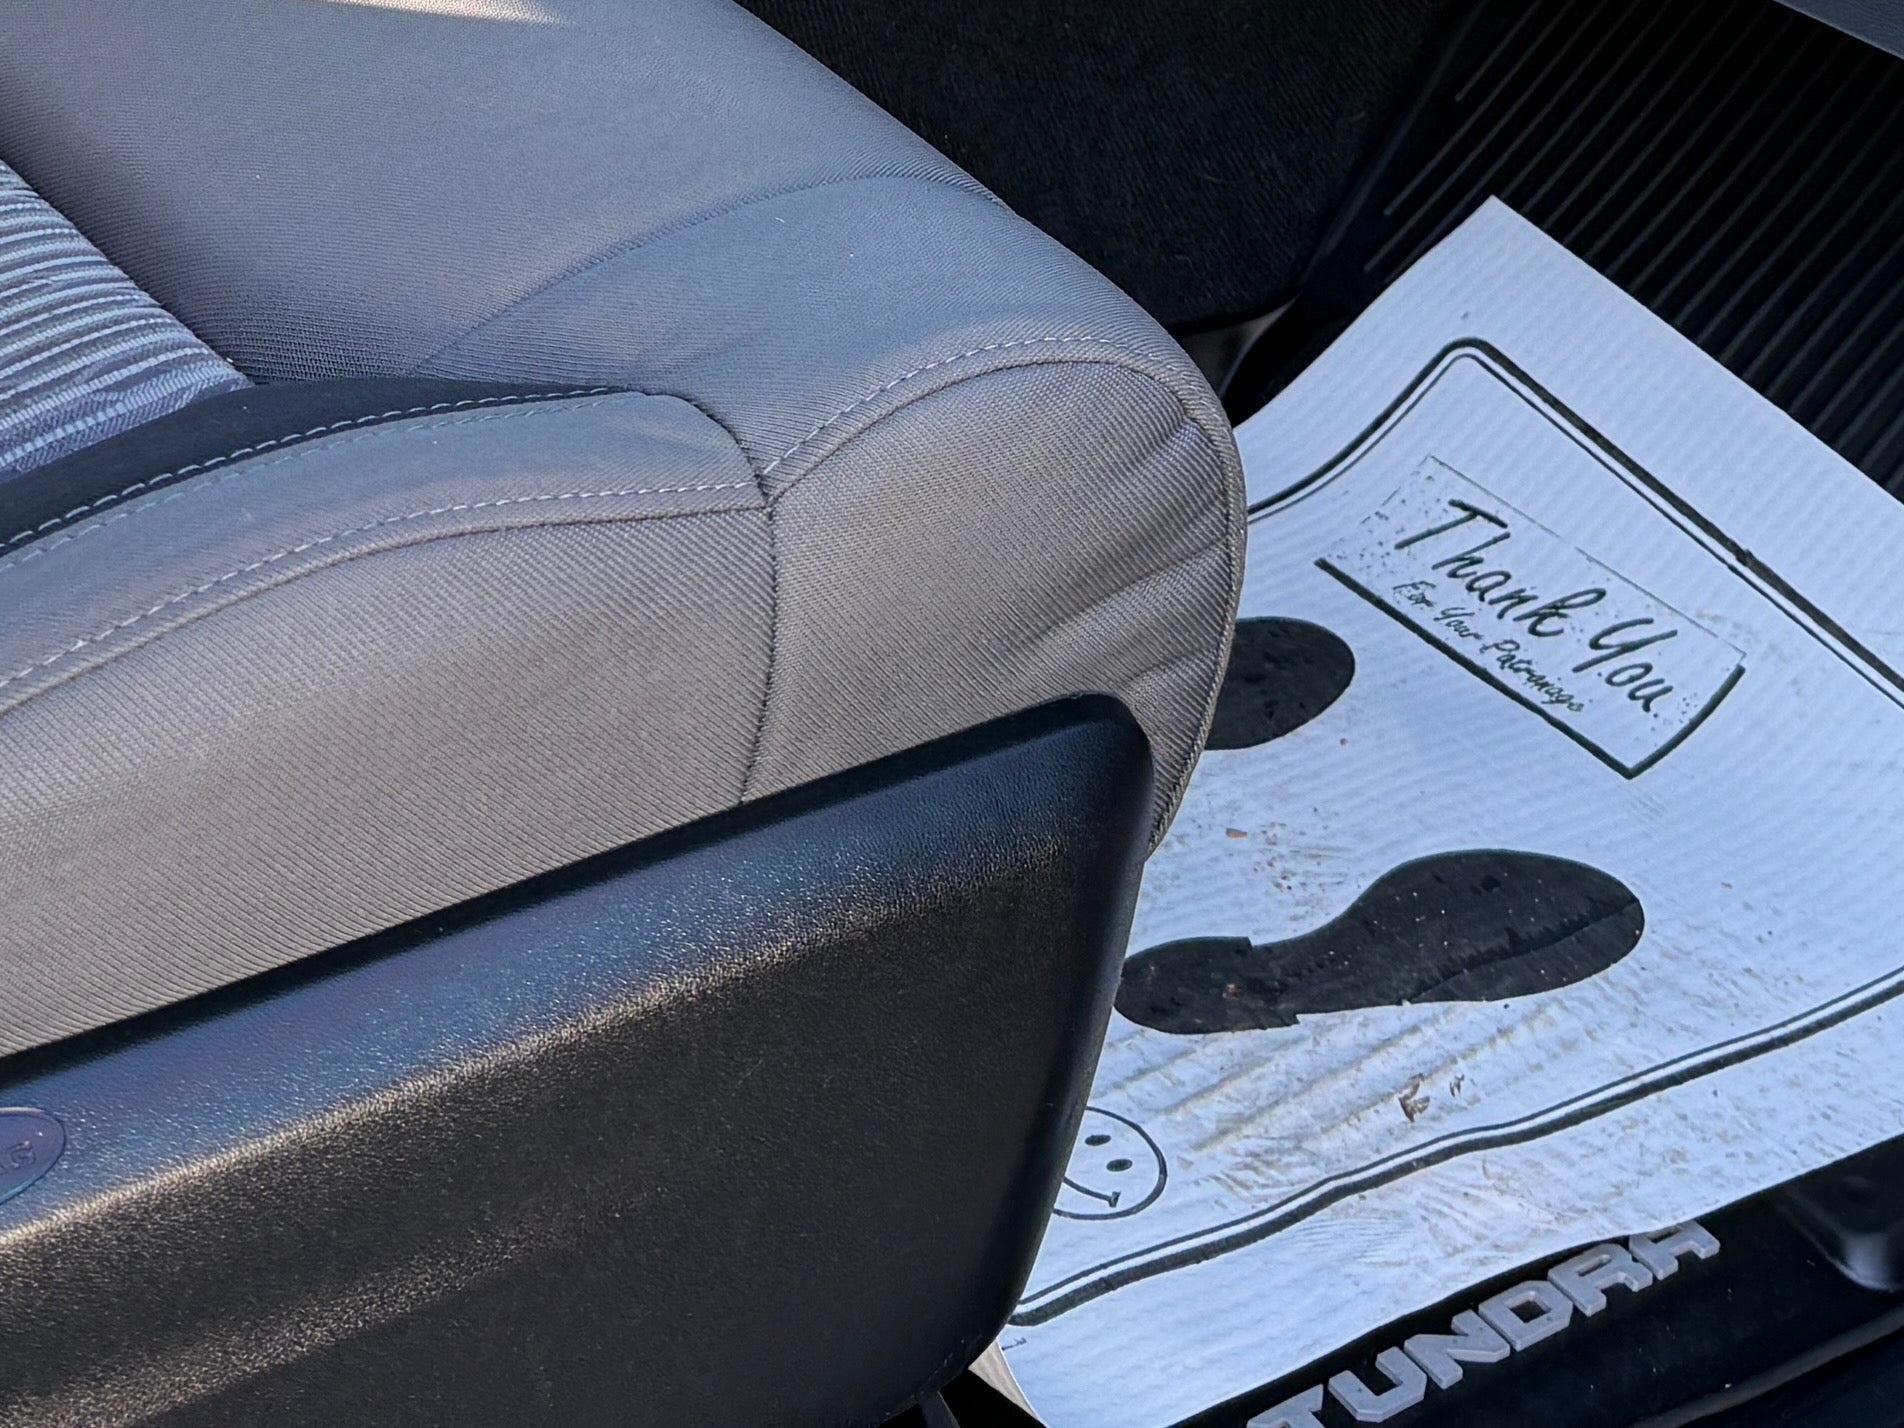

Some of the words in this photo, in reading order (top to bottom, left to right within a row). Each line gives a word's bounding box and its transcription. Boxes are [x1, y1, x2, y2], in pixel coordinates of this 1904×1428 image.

[1394, 498, 1608, 638] Thank
[1571, 617, 1679, 715] You
[1434, 607, 1483, 642] Your
